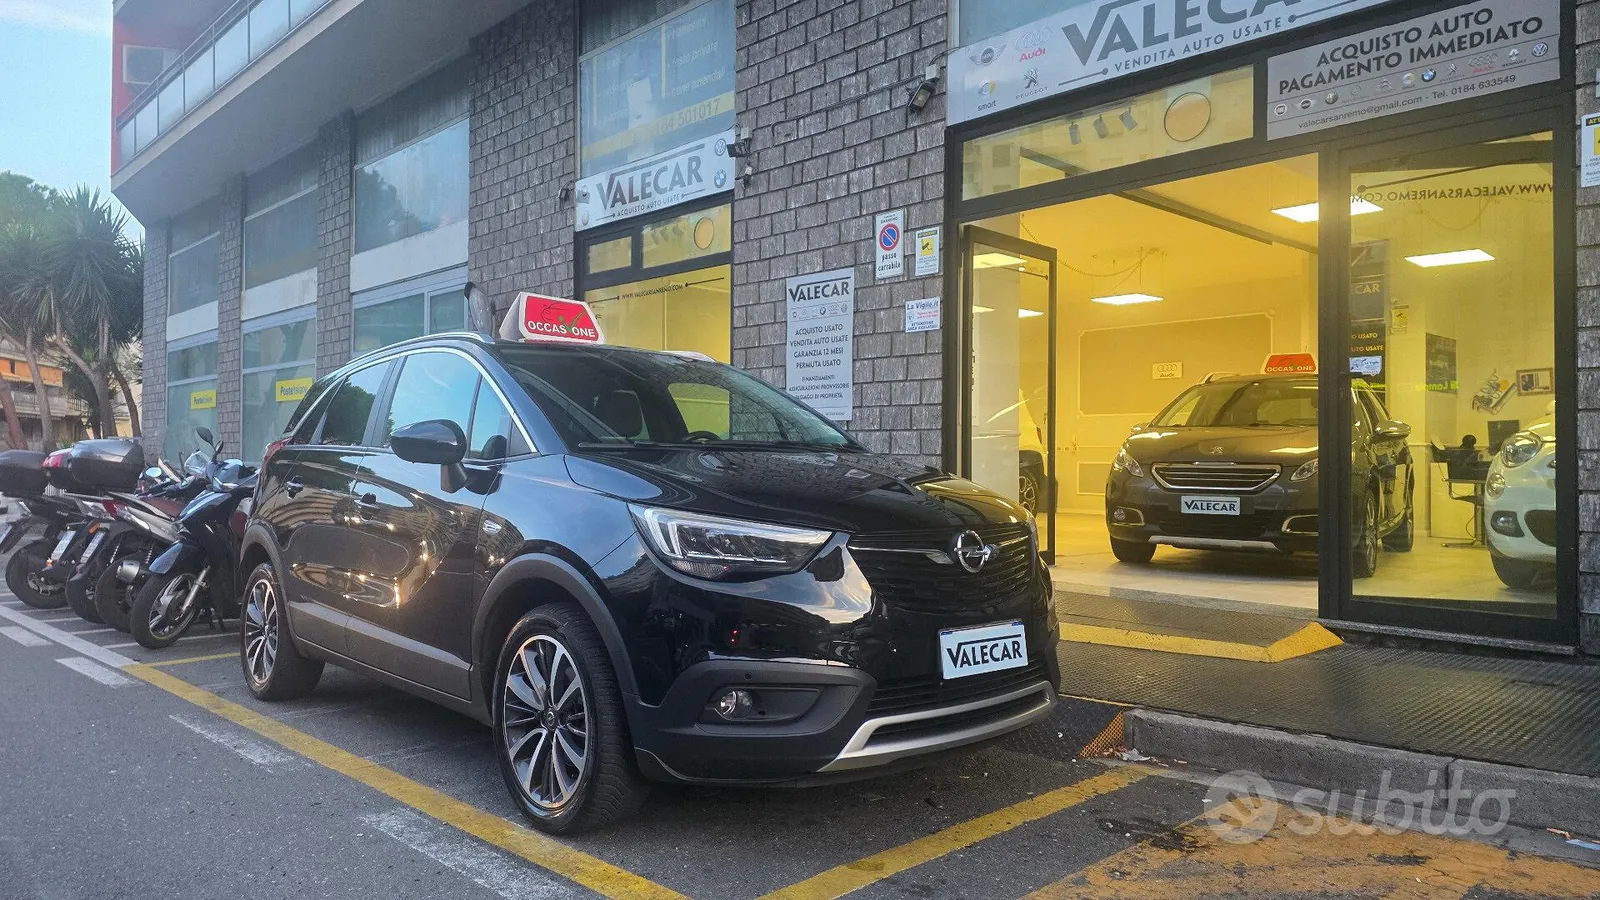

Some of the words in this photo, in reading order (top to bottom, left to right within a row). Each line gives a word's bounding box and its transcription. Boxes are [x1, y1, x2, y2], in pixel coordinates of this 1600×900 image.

[1317, 26, 1422, 67] ACQUISTO
[1427, 8, 1494, 39] AUTO
[1114, 48, 1176, 73] VENDITA
[1182, 33, 1224, 53] AUTO
[1232, 17, 1281, 40] USATE
[1018, 48, 1046, 62] Audi
[1279, 50, 1402, 95] PAGAMENTO
[1409, 17, 1543, 64] IMMEDIATO
[1015, 86, 1048, 100] PEUGEOT
[977, 99, 997, 112] smart
[1297, 95, 1422, 129] valecarsanremo@gmail.com
[1431, 90, 1449, 100] Tel.
[1451, 83, 1476, 96] 0184
[1478, 74, 1517, 90] 633549
[678, 98, 721, 125] 501017
[596, 144, 705, 211] VALECAR
[617, 203, 645, 218] ACQUISTO
[646, 200, 662, 210] AUTO
[881, 252, 897, 262] passo
[878, 261, 901, 272] carrabile
[788, 276, 851, 303] VALECAR
[795, 326, 824, 336] ACQUISTO
[824, 323, 843, 333] USATO
[789, 338, 813, 347] VENDITA
[813, 336, 830, 345] AUTO
[831, 334, 849, 343] USATE
[793, 348, 823, 358] GARANZIA
[830, 347, 844, 355] MESI
[796, 360, 822, 369] PERMUTA
[822, 358, 841, 367] USATO
[1184, 499, 1237, 512] VALECAR
[946, 633, 1023, 669] VALECAR
